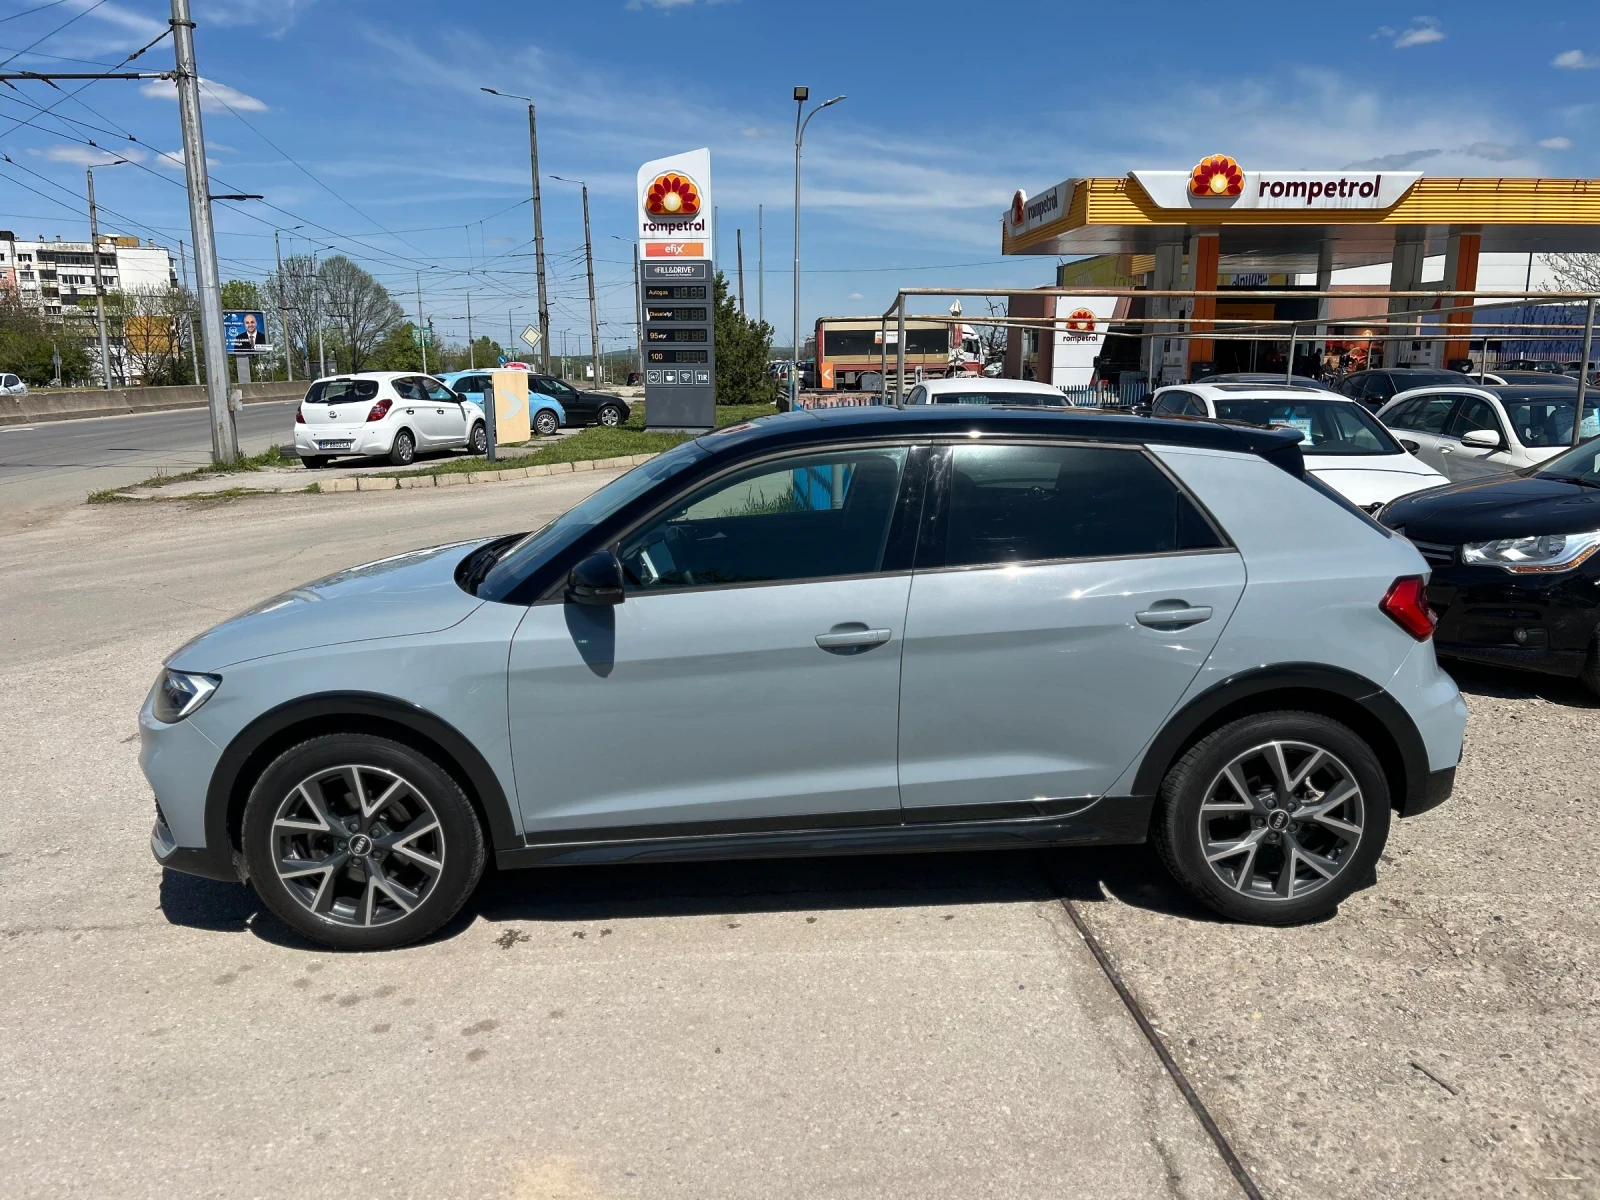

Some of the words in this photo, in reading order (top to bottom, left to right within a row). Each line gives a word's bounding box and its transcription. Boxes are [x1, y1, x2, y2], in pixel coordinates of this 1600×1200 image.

[1259, 175, 1381, 205] rompetrol
[1028, 187, 1058, 221] rompetrol
[643, 218, 705, 235] rompetrol
[665, 244, 685, 255] efix
[648, 289, 669, 297] Autogas
[649, 332, 659, 340] 95
[1062, 333, 1098, 343] rompetrol
